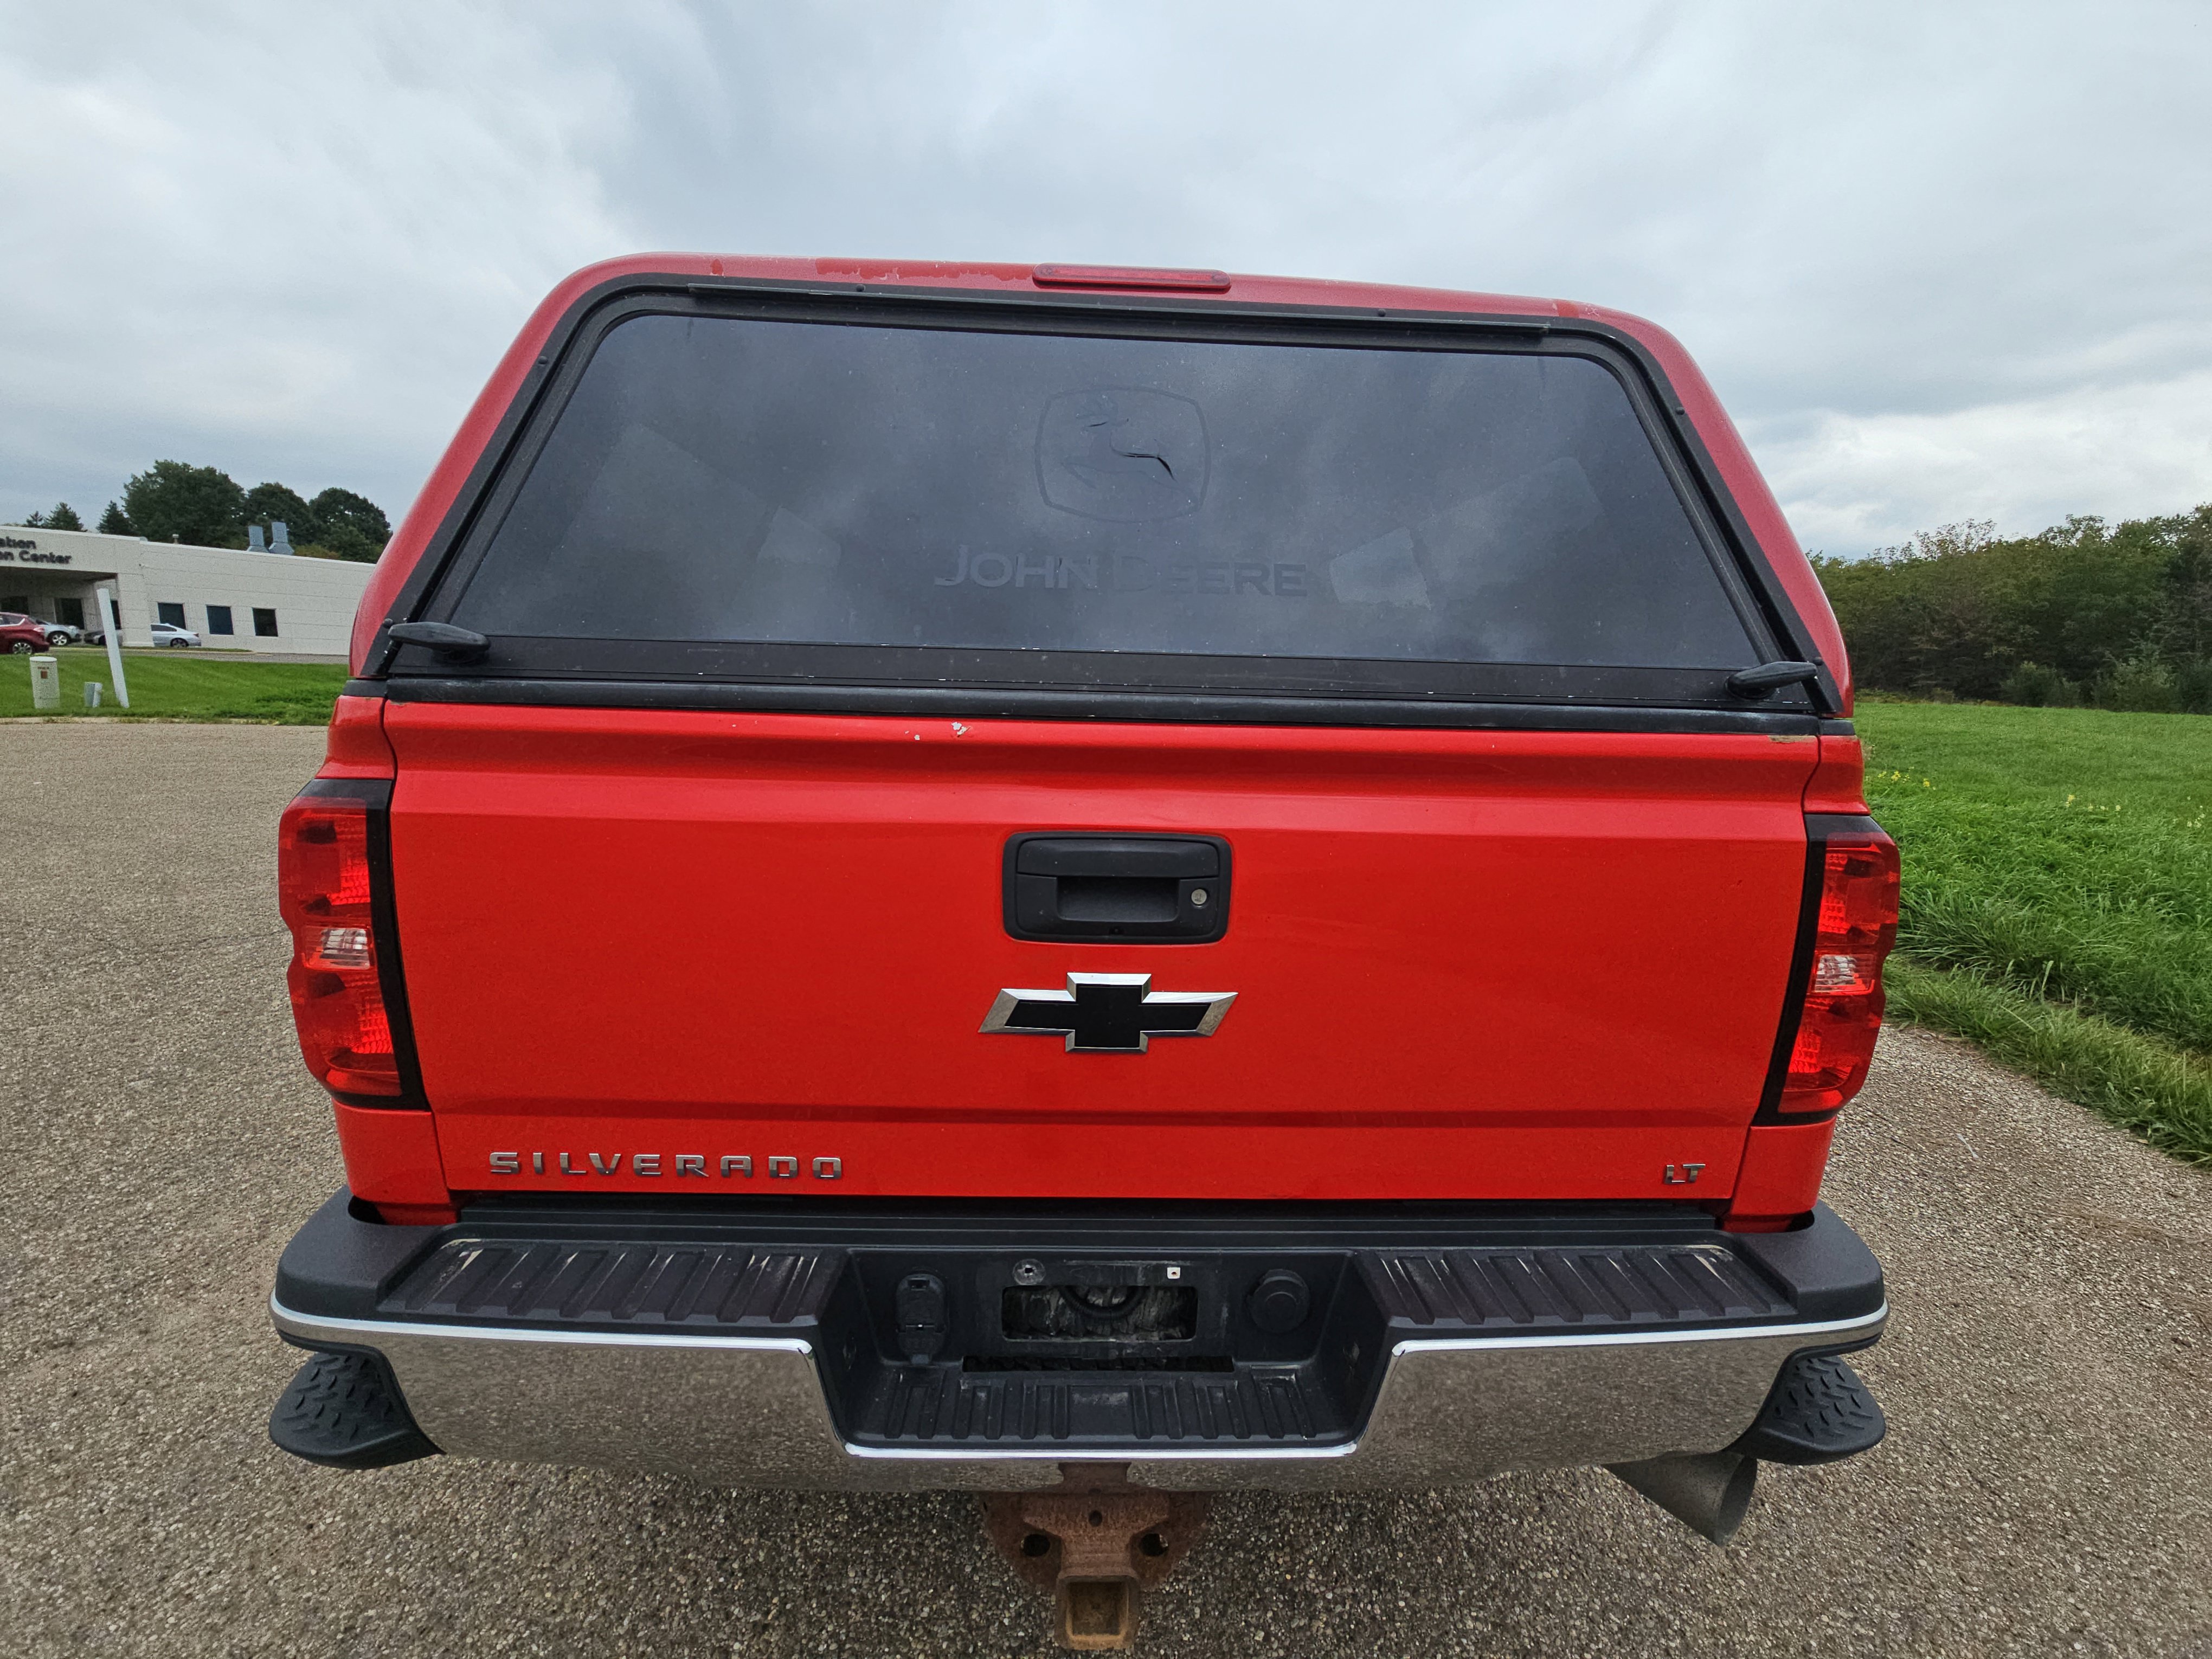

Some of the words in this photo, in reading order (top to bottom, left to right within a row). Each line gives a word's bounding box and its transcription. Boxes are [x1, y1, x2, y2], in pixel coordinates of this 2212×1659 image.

[19, 550, 72, 564] Center
[934, 544, 1099, 591] JOHN
[1114, 555, 1308, 597] DEERE
[489, 1152, 844, 1179] SILVERADO
[1664, 1163, 1706, 1184] LT
